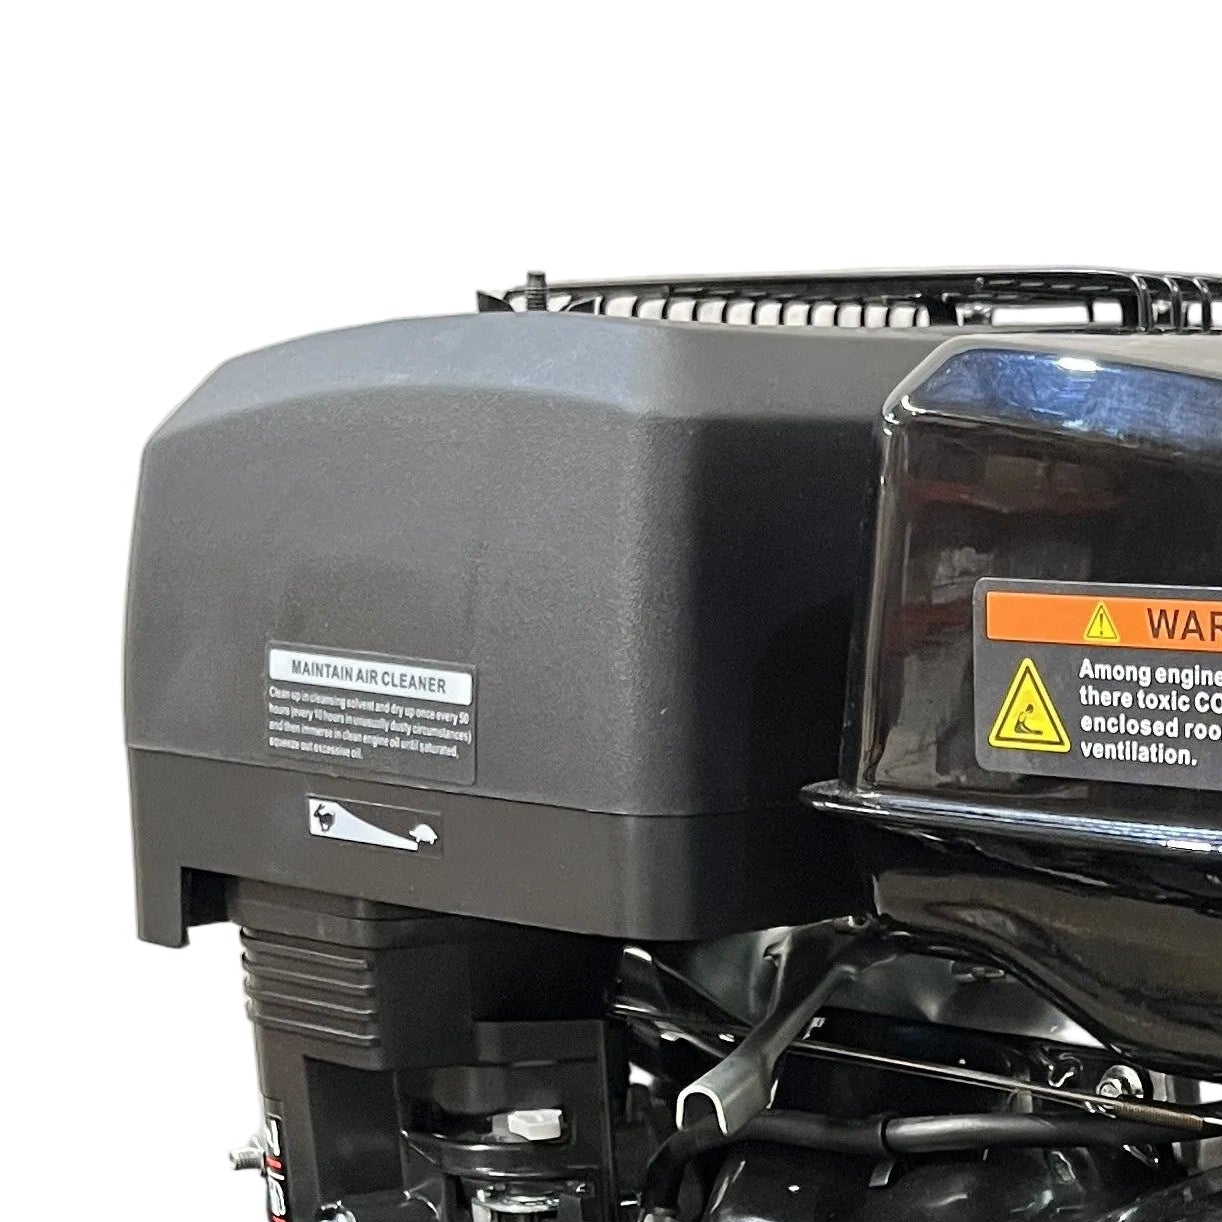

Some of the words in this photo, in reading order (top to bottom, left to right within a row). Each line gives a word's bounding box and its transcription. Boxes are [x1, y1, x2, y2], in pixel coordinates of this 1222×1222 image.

[291, 659, 353, 682] MAINTAIN
[356, 668, 378, 685] AIR
[381, 671, 447, 694] CLEANER
[1079, 657, 1152, 687] Among
[1079, 684, 1133, 708] there
[1137, 689, 1191, 712] toxic
[1080, 712, 1179, 738] enclosed
[1080, 740, 1198, 767] ventilation.
